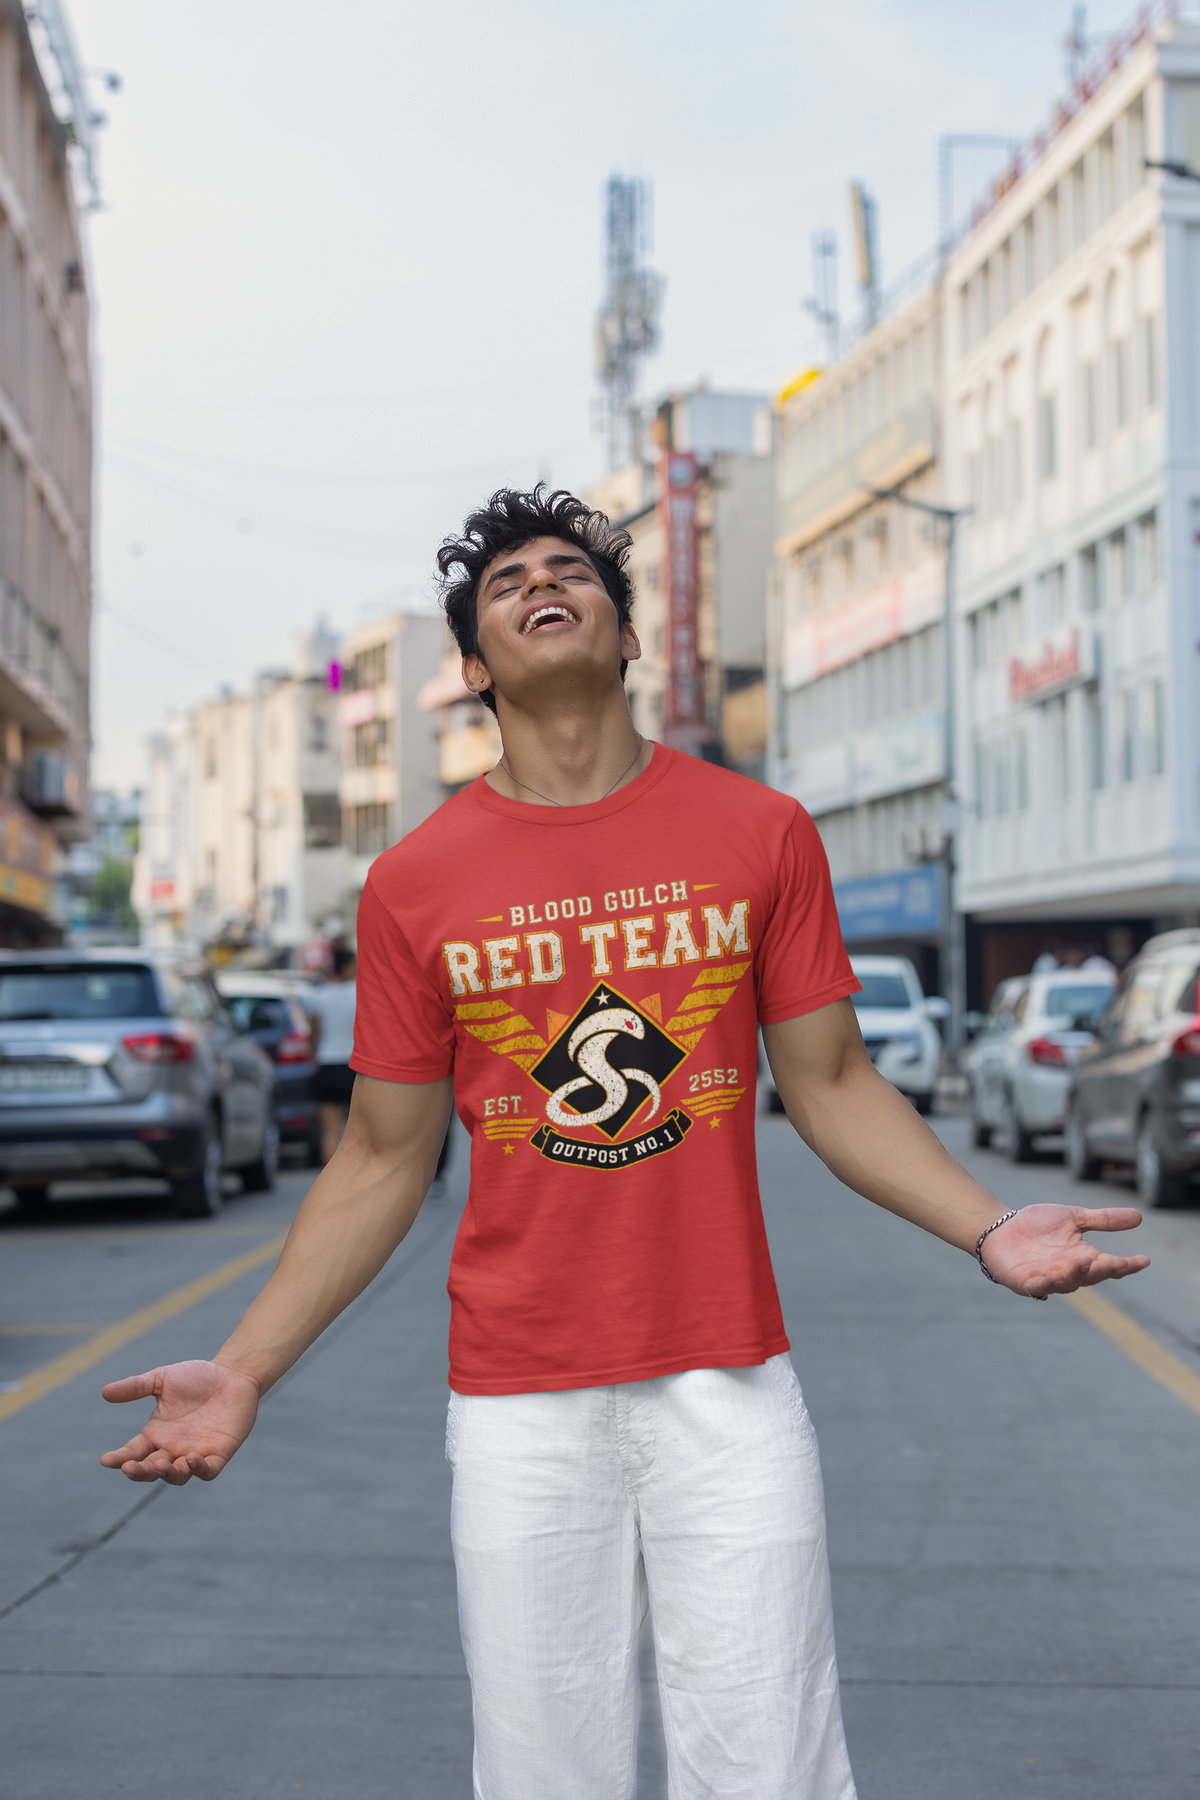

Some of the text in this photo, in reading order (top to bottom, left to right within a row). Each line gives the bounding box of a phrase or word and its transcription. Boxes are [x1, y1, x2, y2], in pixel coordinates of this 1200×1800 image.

[510, 880, 688, 927] BLOOD GULCH
[442, 930, 565, 997] RED
[579, 899, 751, 977] TEAM
[688, 1068, 739, 1093] 2552
[484, 1096, 527, 1117] EST.
[552, 1129, 676, 1164] OUTPOST NO. 1
